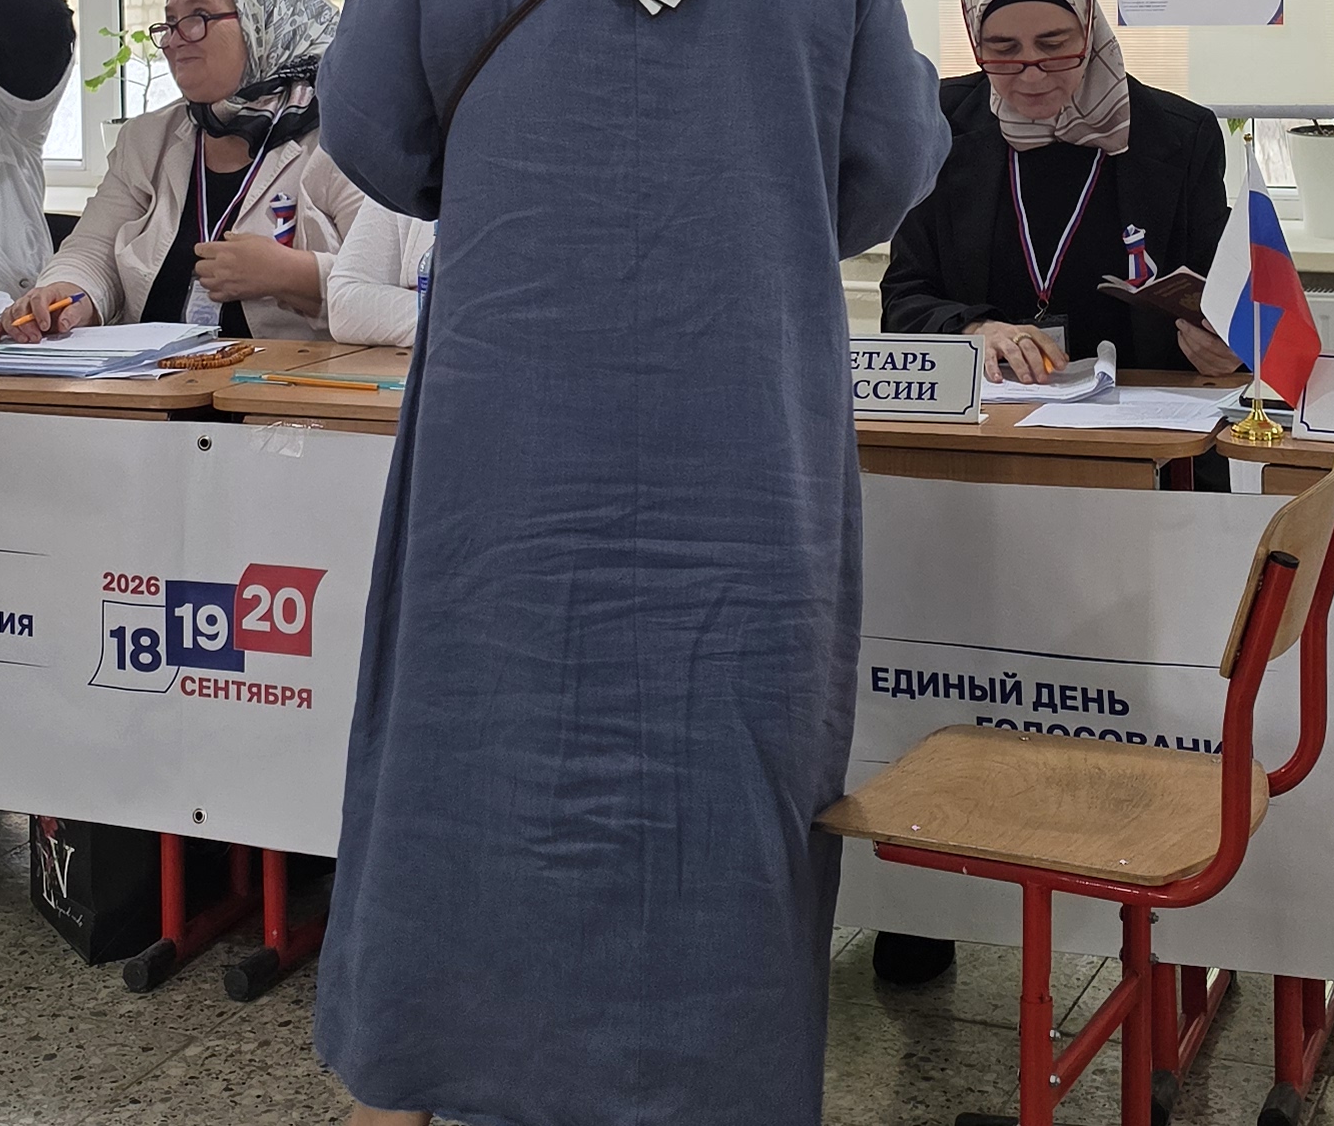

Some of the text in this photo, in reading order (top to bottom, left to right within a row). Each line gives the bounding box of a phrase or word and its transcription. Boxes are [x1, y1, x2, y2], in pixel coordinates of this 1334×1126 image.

[850, 351, 936, 371] ЕТАРЬ
[853, 380, 938, 401] ССИИ
[102, 572, 161, 596] 2026
[109, 584, 307, 673] 18 19 20
[179, 675, 313, 710] СЕНТЯБРЯ
[871, 666, 1130, 716] ЕДИНЫЙ ДЕНЬ
